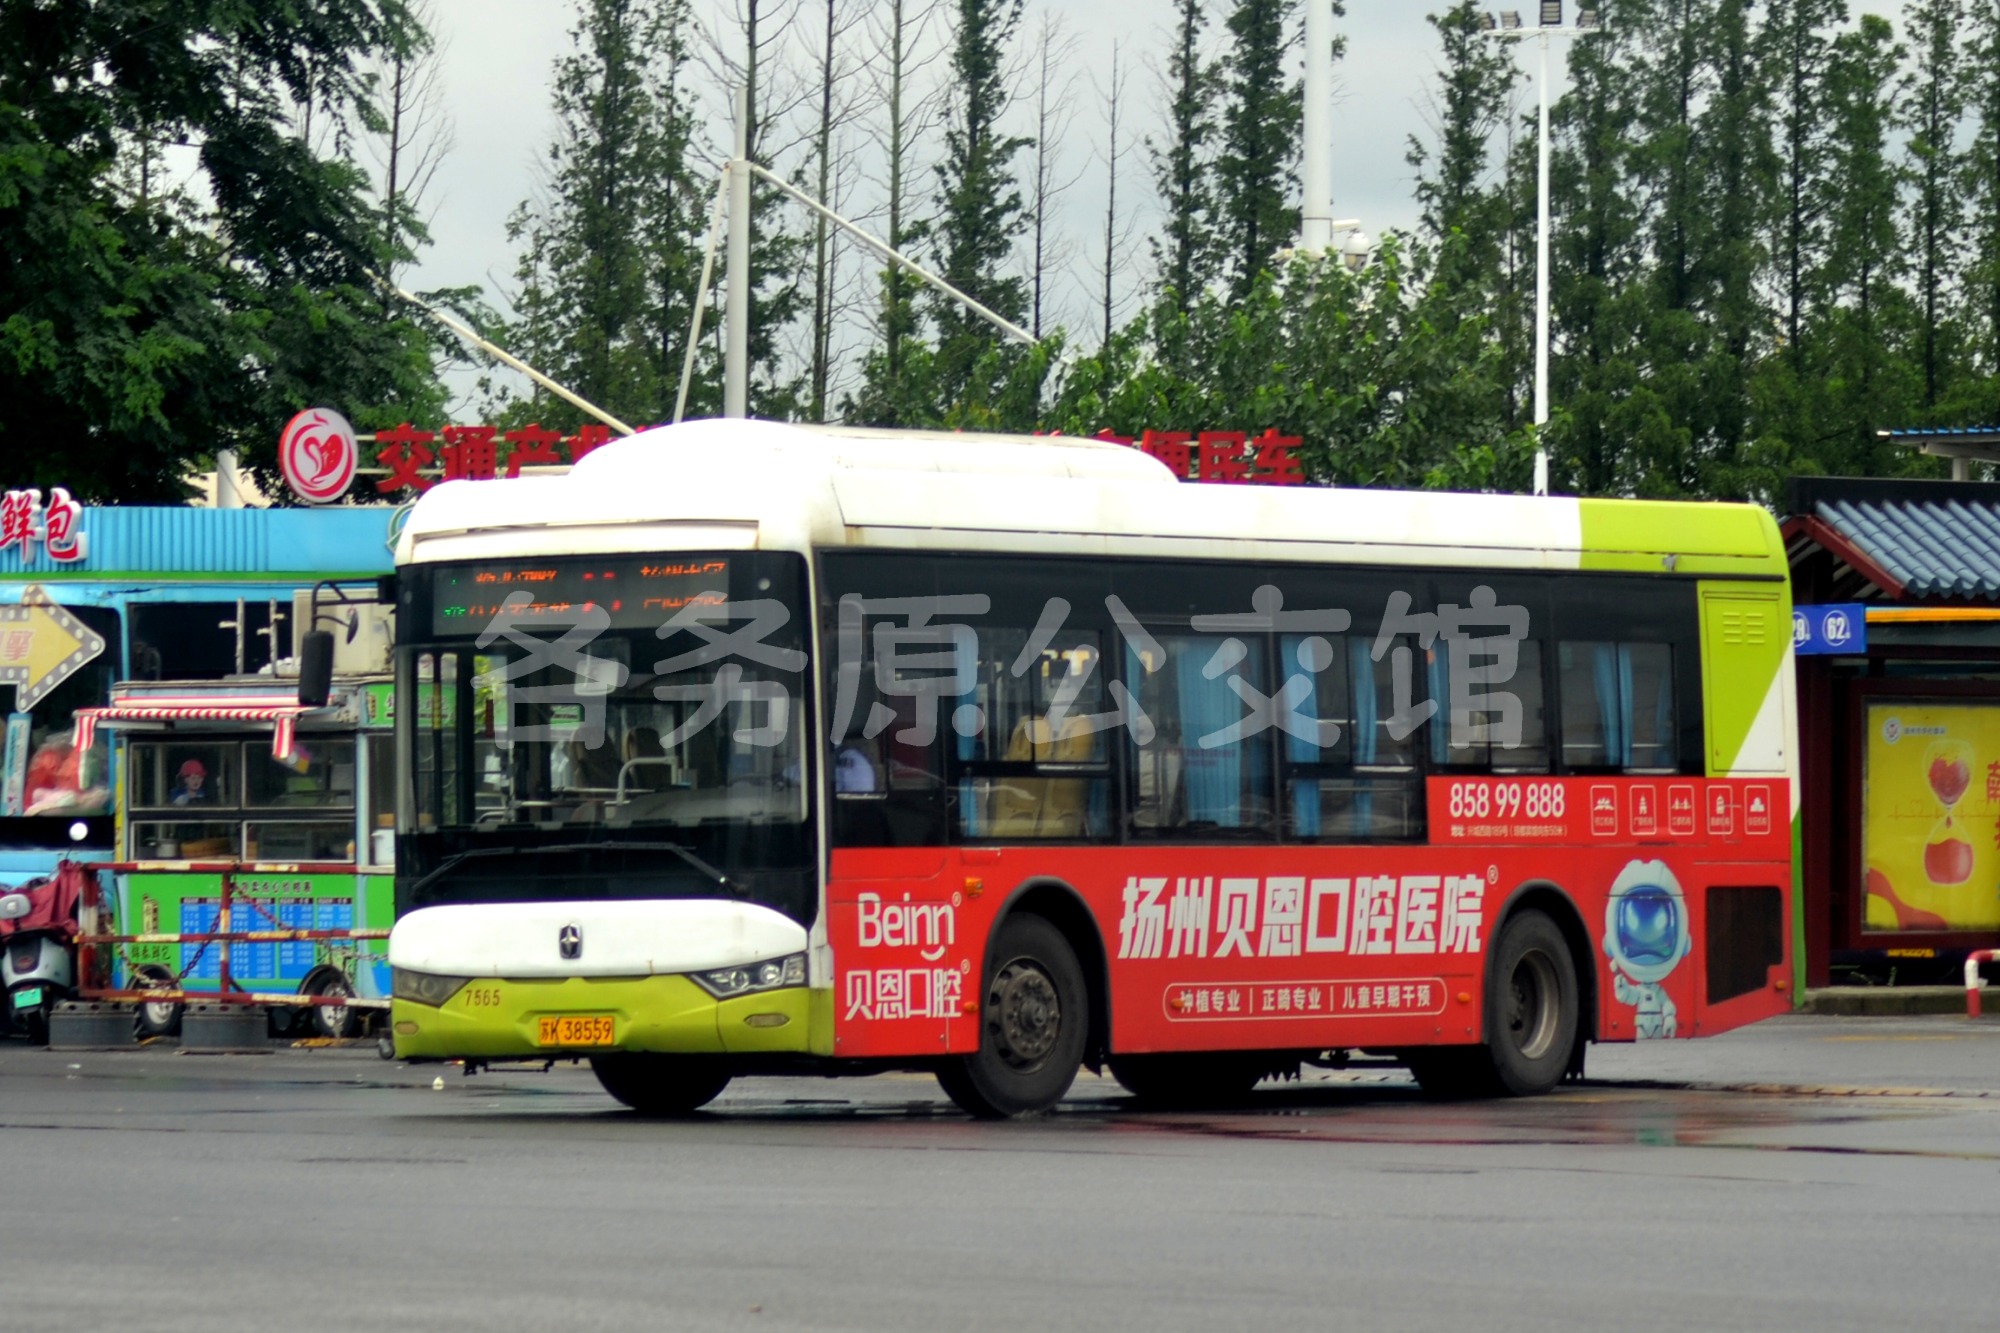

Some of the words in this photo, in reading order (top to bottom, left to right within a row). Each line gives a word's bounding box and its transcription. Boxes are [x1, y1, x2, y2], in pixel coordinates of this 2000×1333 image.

[1450, 783, 1489, 818] 858
[1495, 783, 1521, 818] 99
[1526, 783, 1565, 818] 888
[858, 892, 954, 947] Beinn
[1117, 874, 1484, 959] 扬州贝恩口腔医院
[465, 989, 500, 1007] 7565
[844, 968, 961, 1021] 贝恩口腔
[1262, 987, 1322, 1011] 正畸专业
[1342, 984, 1431, 1009] 儿童早期干预
